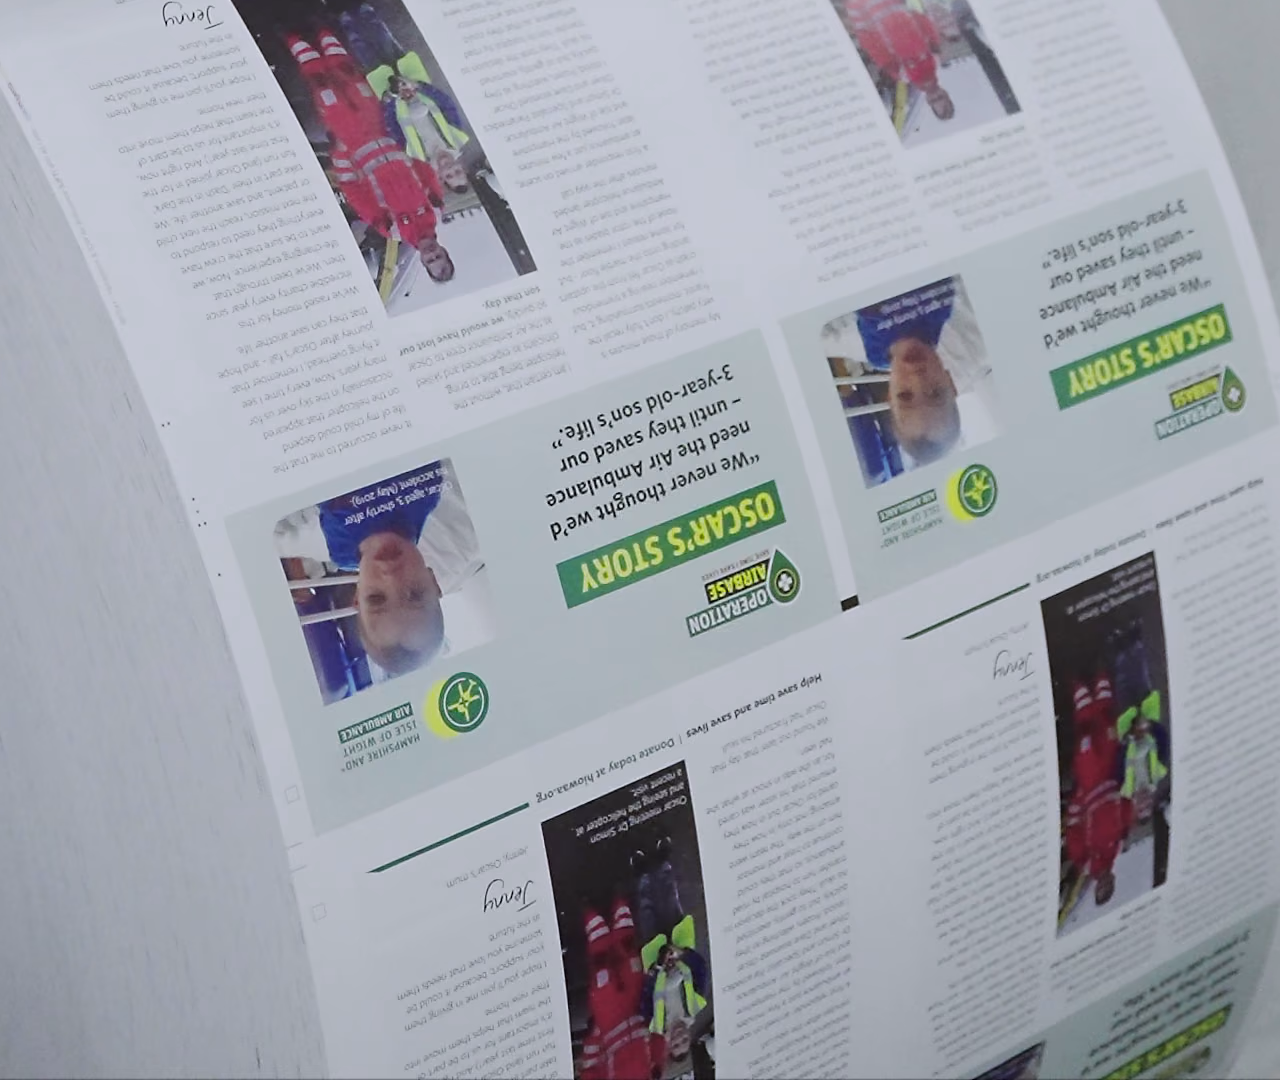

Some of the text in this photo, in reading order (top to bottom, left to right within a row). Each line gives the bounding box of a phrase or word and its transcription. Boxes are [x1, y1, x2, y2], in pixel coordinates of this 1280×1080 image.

[161, 1, 223, 30] Jenny
[1049, 229, 1184, 290] until they saved our
[1038, 249, 1203, 320] need the Air Ambulance
[1139, 285, 1177, 309] never
[1078, 301, 1136, 332] thought
[1042, 324, 1078, 349] we’d
[1071, 311, 1226, 394] OSCAR’S STORY
[551, 363, 734, 449] 3-year-old son’s life.”
[688, 399, 728, 428] until
[648, 414, 686, 439] they
[544, 419, 750, 507] need the Air Ambulance
[559, 450, 589, 472] our
[592, 429, 644, 464] saved
[549, 451, 760, 541] “We never thought we’d
[582, 491, 776, 589] OSCAR’S STORY
[708, 564, 767, 600] AIRBASE
[688, 587, 767, 633] OPERATION
[993, 649, 1035, 680] Jenny
[339, 704, 410, 741] AIR AMBULANCE
[342, 718, 417, 758] ISLE OF WIGHT
[535, 672, 822, 803] Help save time and save lives Donate today at hiowaa.org
[366, 732, 420, 762] HAMPSHIRE
[483, 878, 536, 912] Jenny
